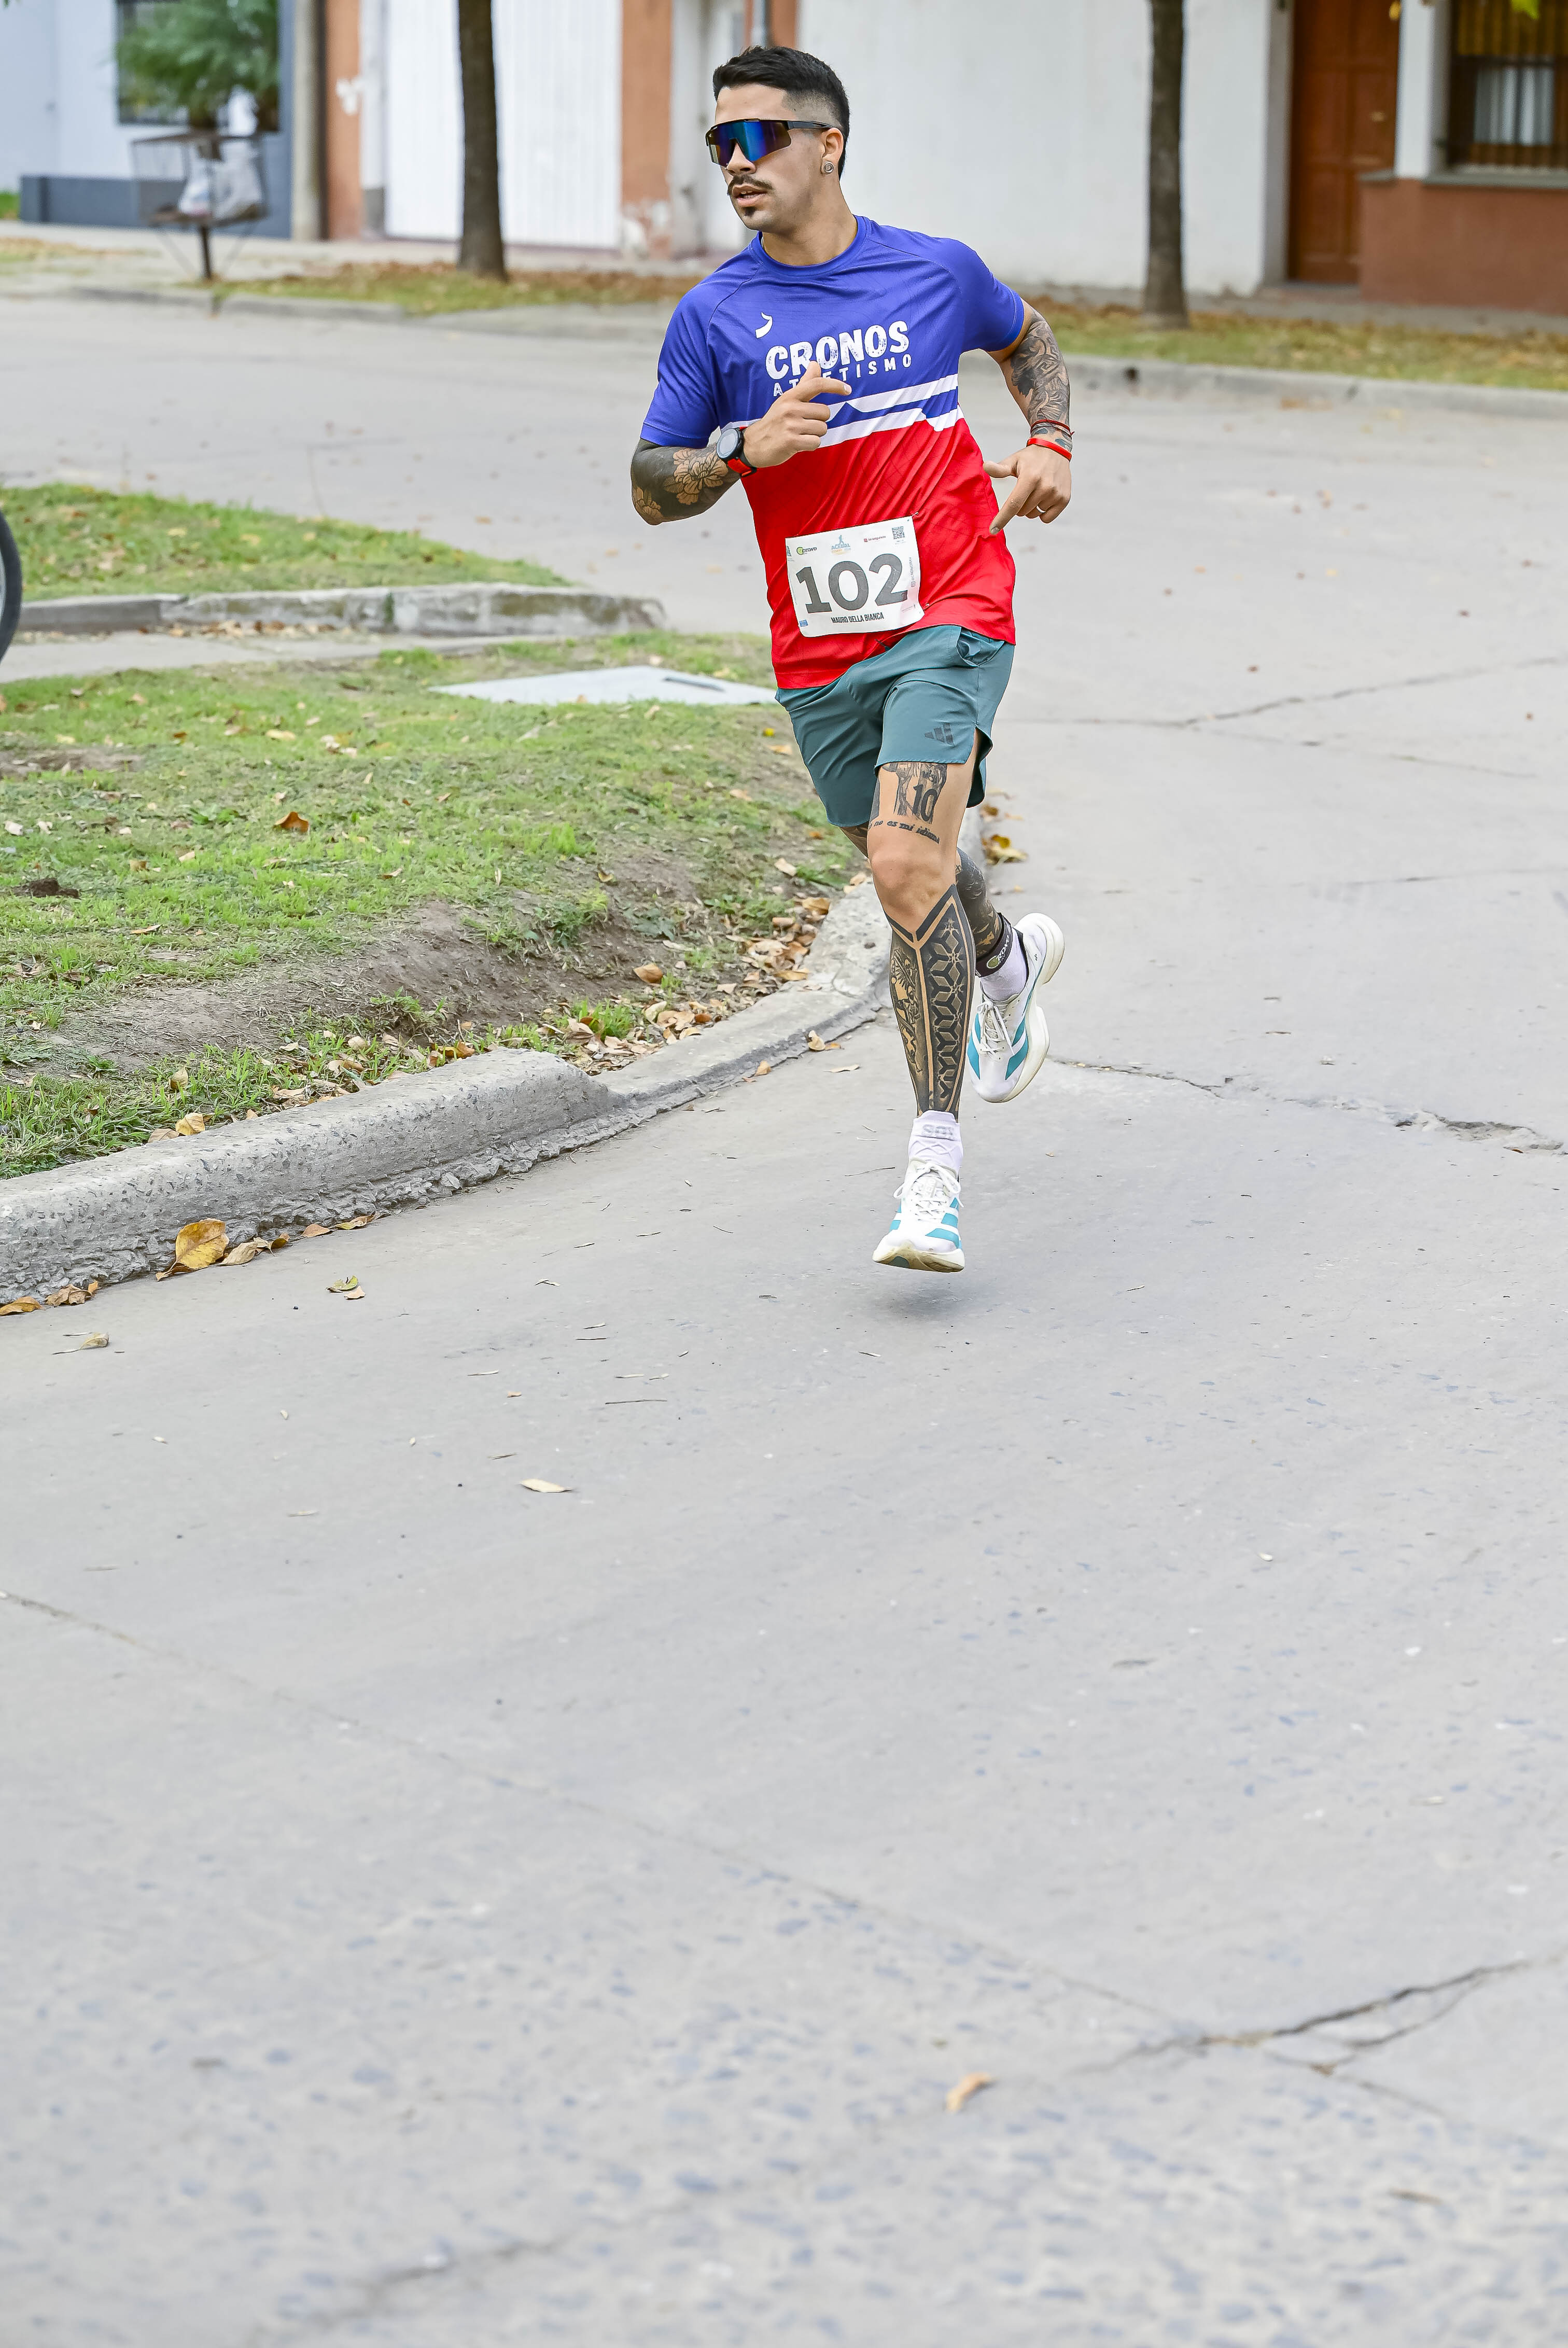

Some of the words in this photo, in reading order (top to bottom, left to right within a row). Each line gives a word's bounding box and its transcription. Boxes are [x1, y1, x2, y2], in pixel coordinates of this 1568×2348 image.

[765, 320, 909, 380] CRONOS
[773, 354, 912, 397] ATTISMO
[796, 553, 908, 613] 102
[848, 614, 864, 623] DELLA
[864, 612, 884, 621] BIANCA
[913, 784, 938, 822] 10
